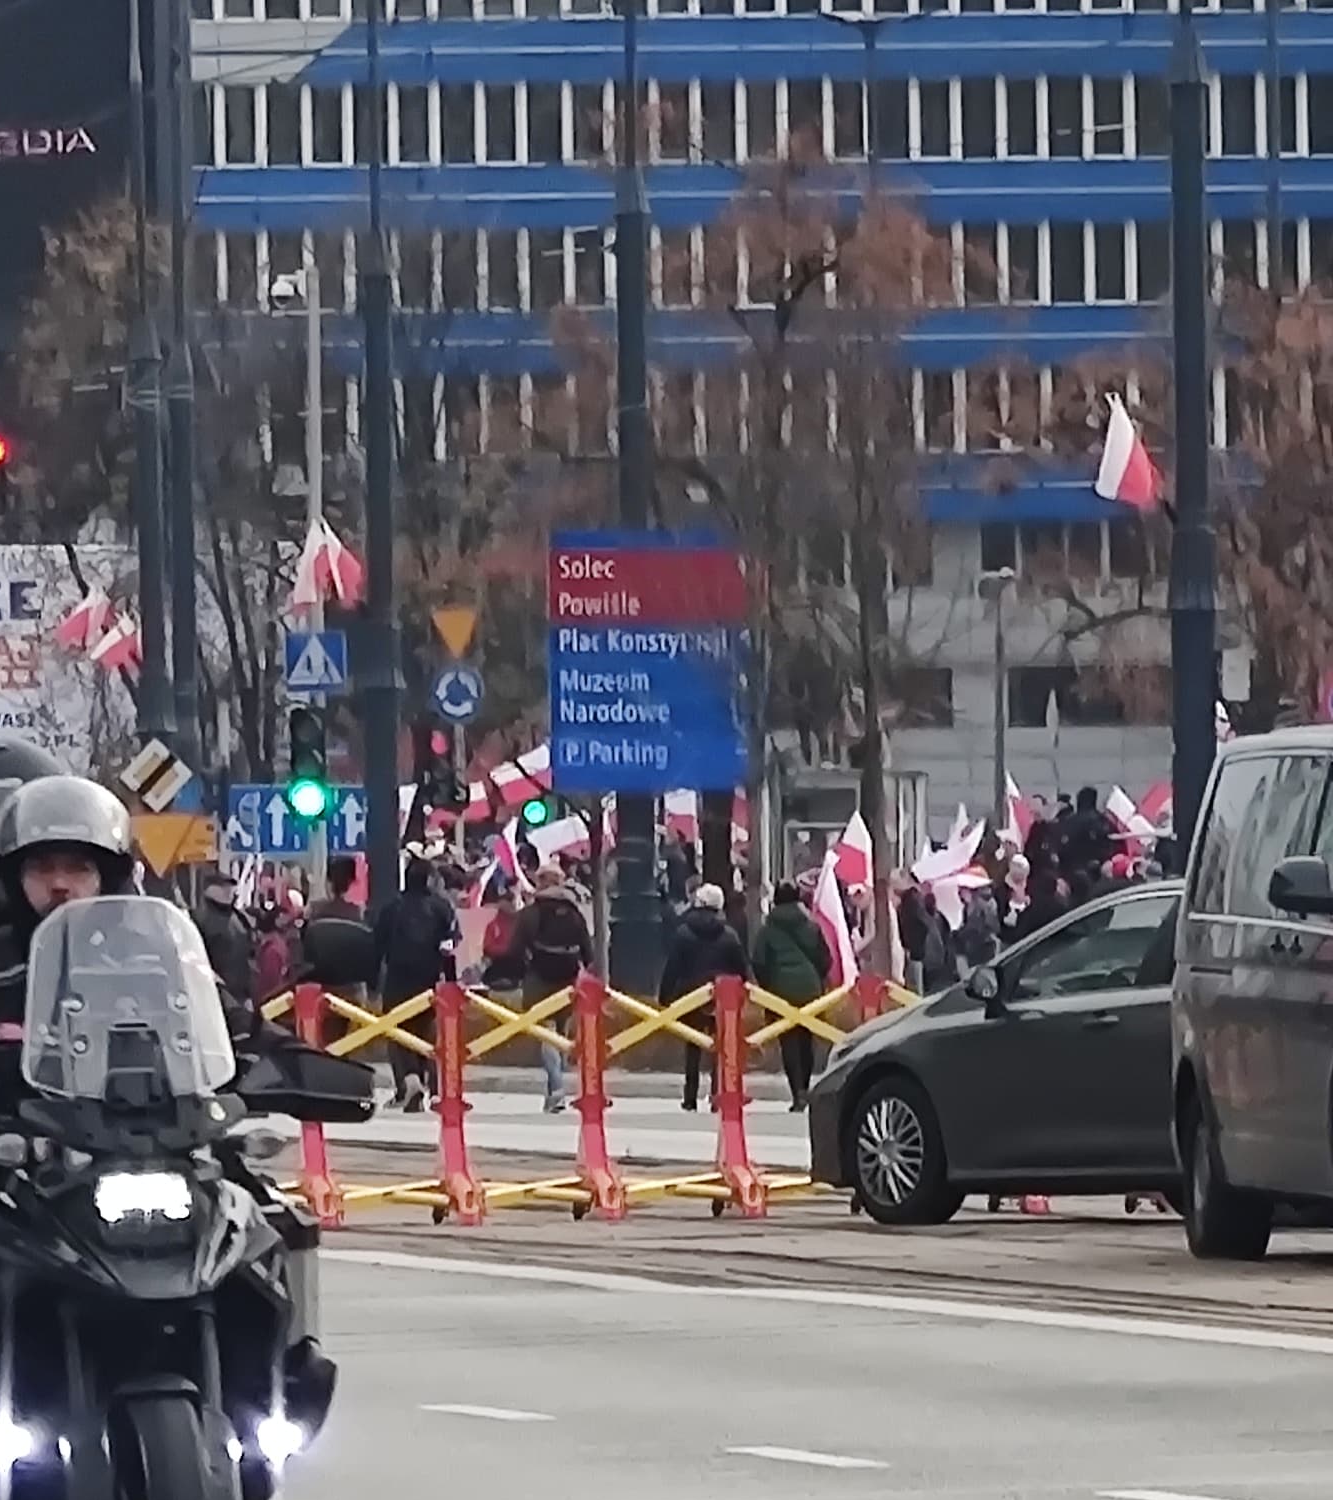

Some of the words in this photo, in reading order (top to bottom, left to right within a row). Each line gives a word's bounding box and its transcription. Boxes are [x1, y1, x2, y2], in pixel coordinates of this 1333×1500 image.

[558, 554, 615, 579] Solec
[607, 628, 728, 659] Konstytji
[559, 670, 650, 693] Muzeum
[559, 699, 670, 723] Narodowe
[588, 740, 668, 770] Parking
